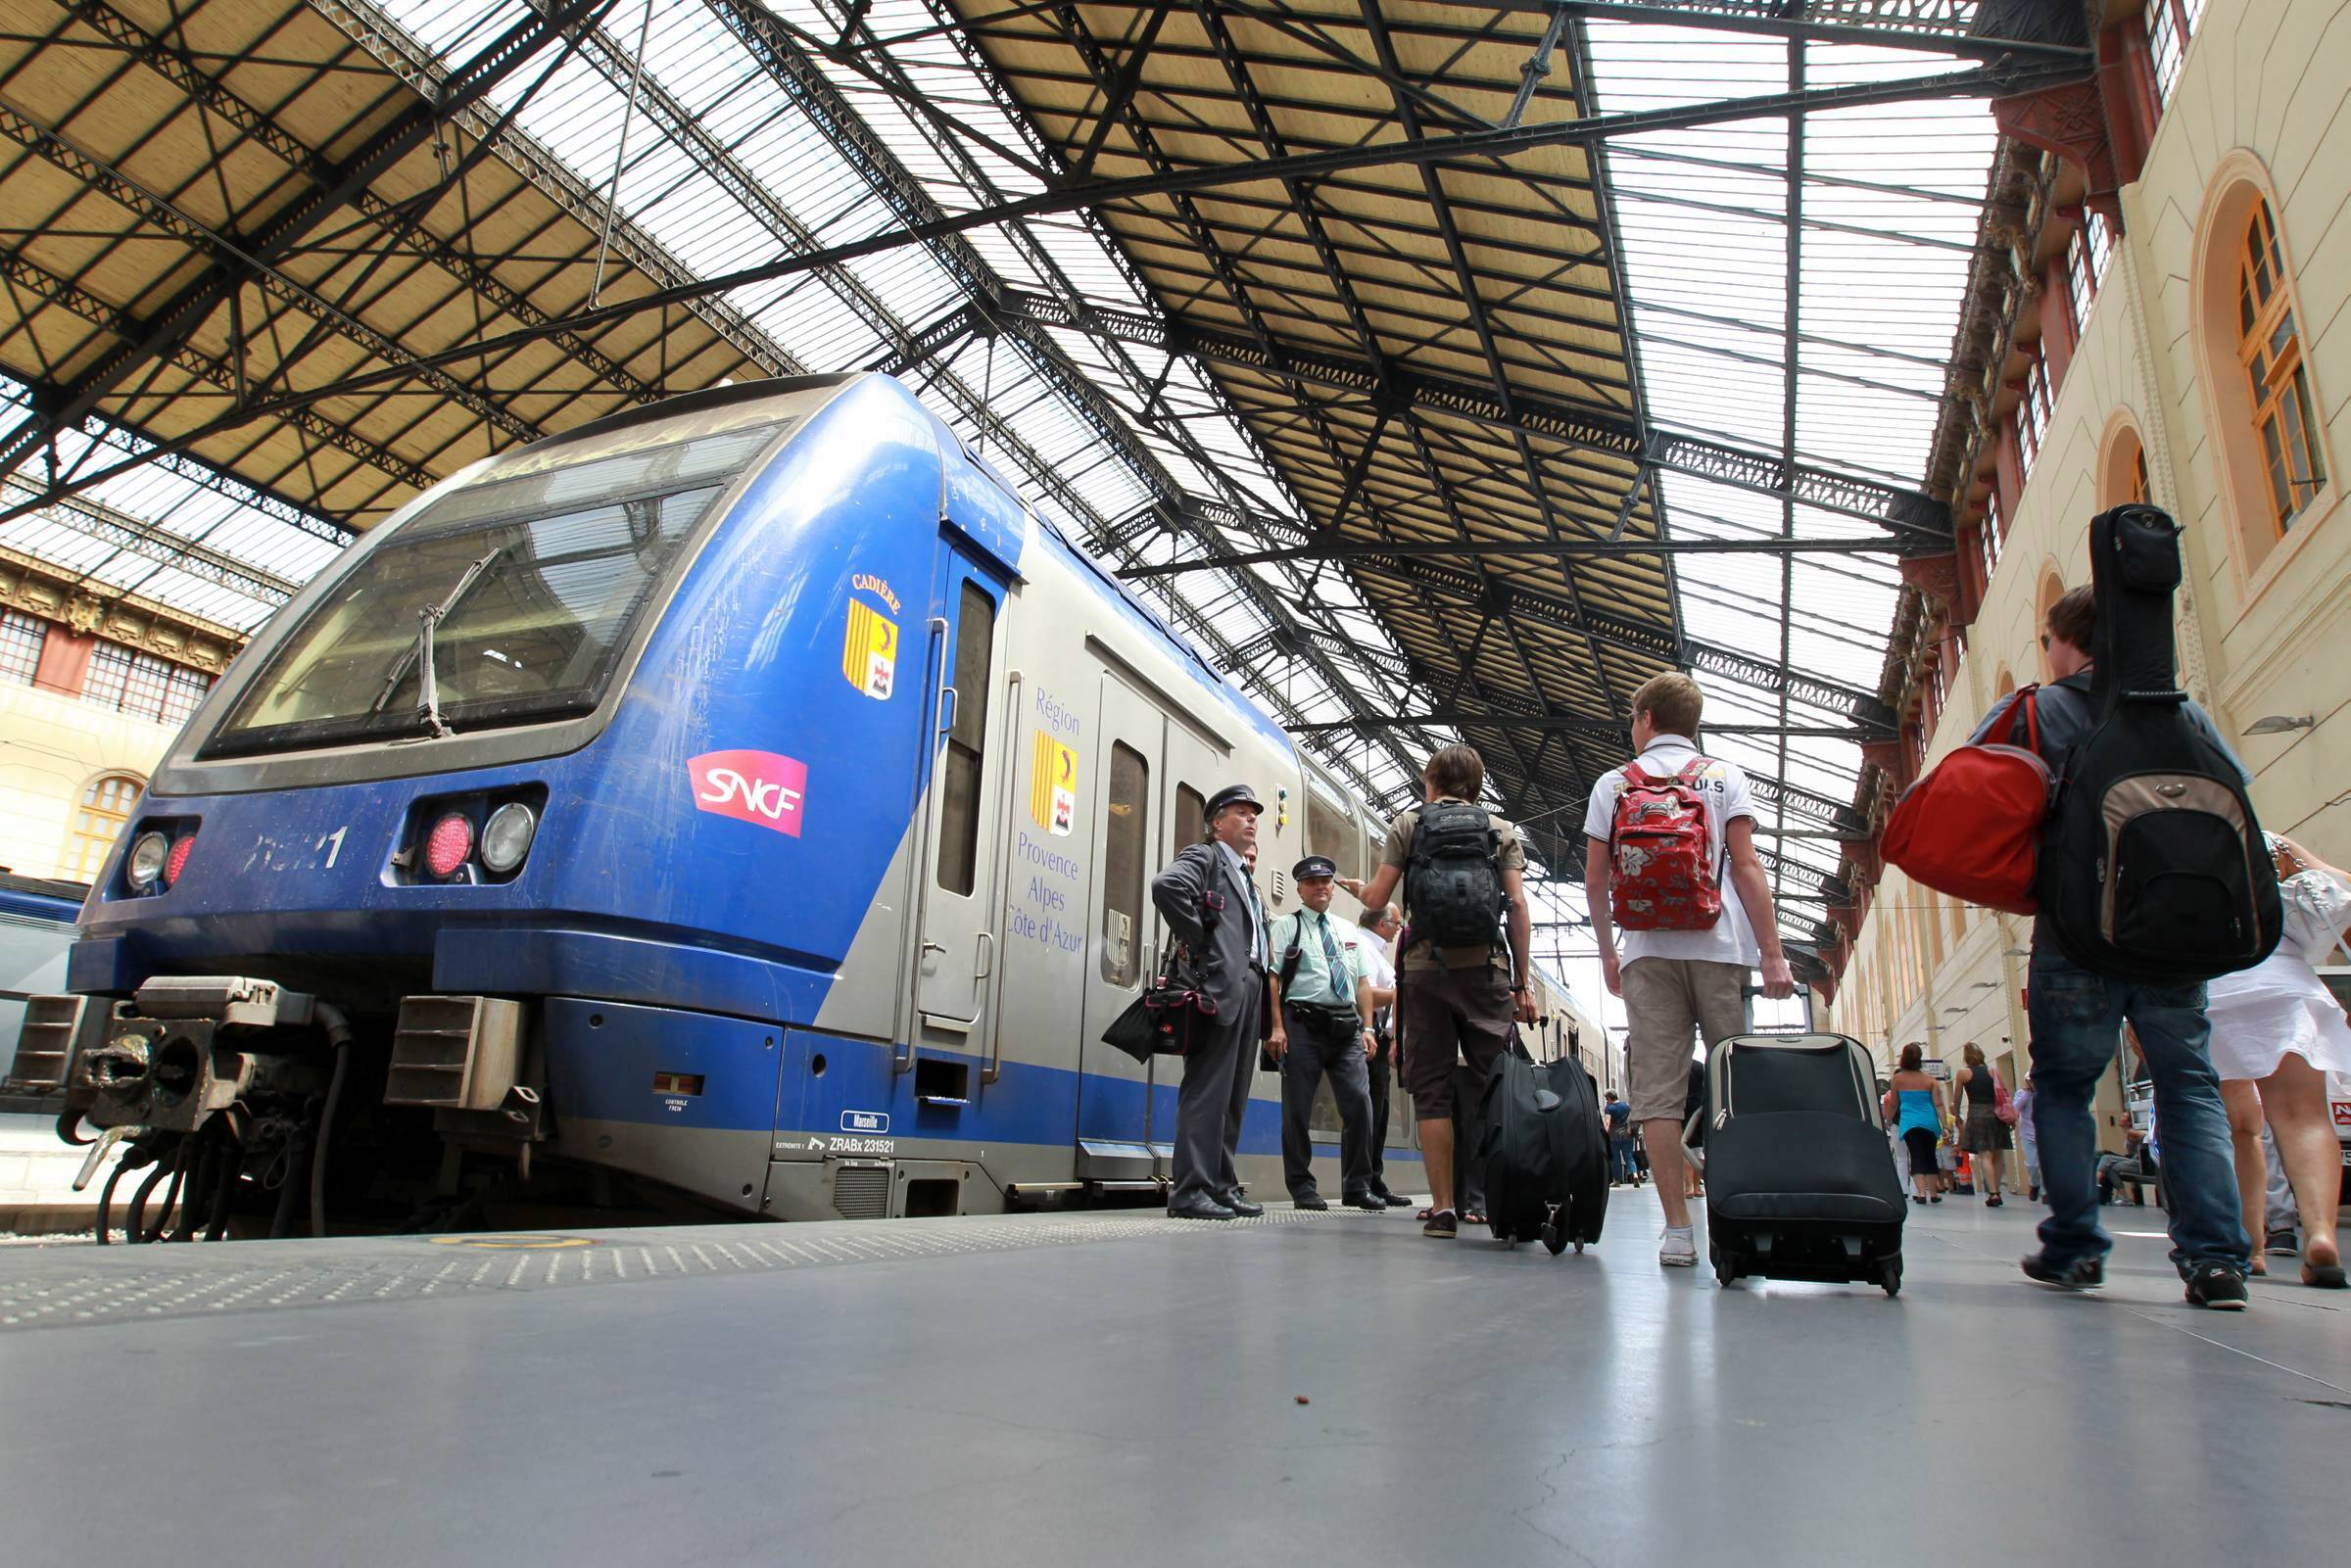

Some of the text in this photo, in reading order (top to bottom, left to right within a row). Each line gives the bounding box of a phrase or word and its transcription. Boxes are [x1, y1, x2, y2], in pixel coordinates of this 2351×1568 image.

[852, 573, 901, 615] CADIÈRE
[1035, 687, 1080, 736] Région
[699, 768, 801, 820] SNCF
[1018, 832, 1079, 880] Provence
[1028, 875, 1065, 913] Alpes
[1039, 916, 1082, 953] d'Azur
[853, 1114, 879, 1128] Marseille
[829, 1137, 894, 1153] ZRABx 231521
